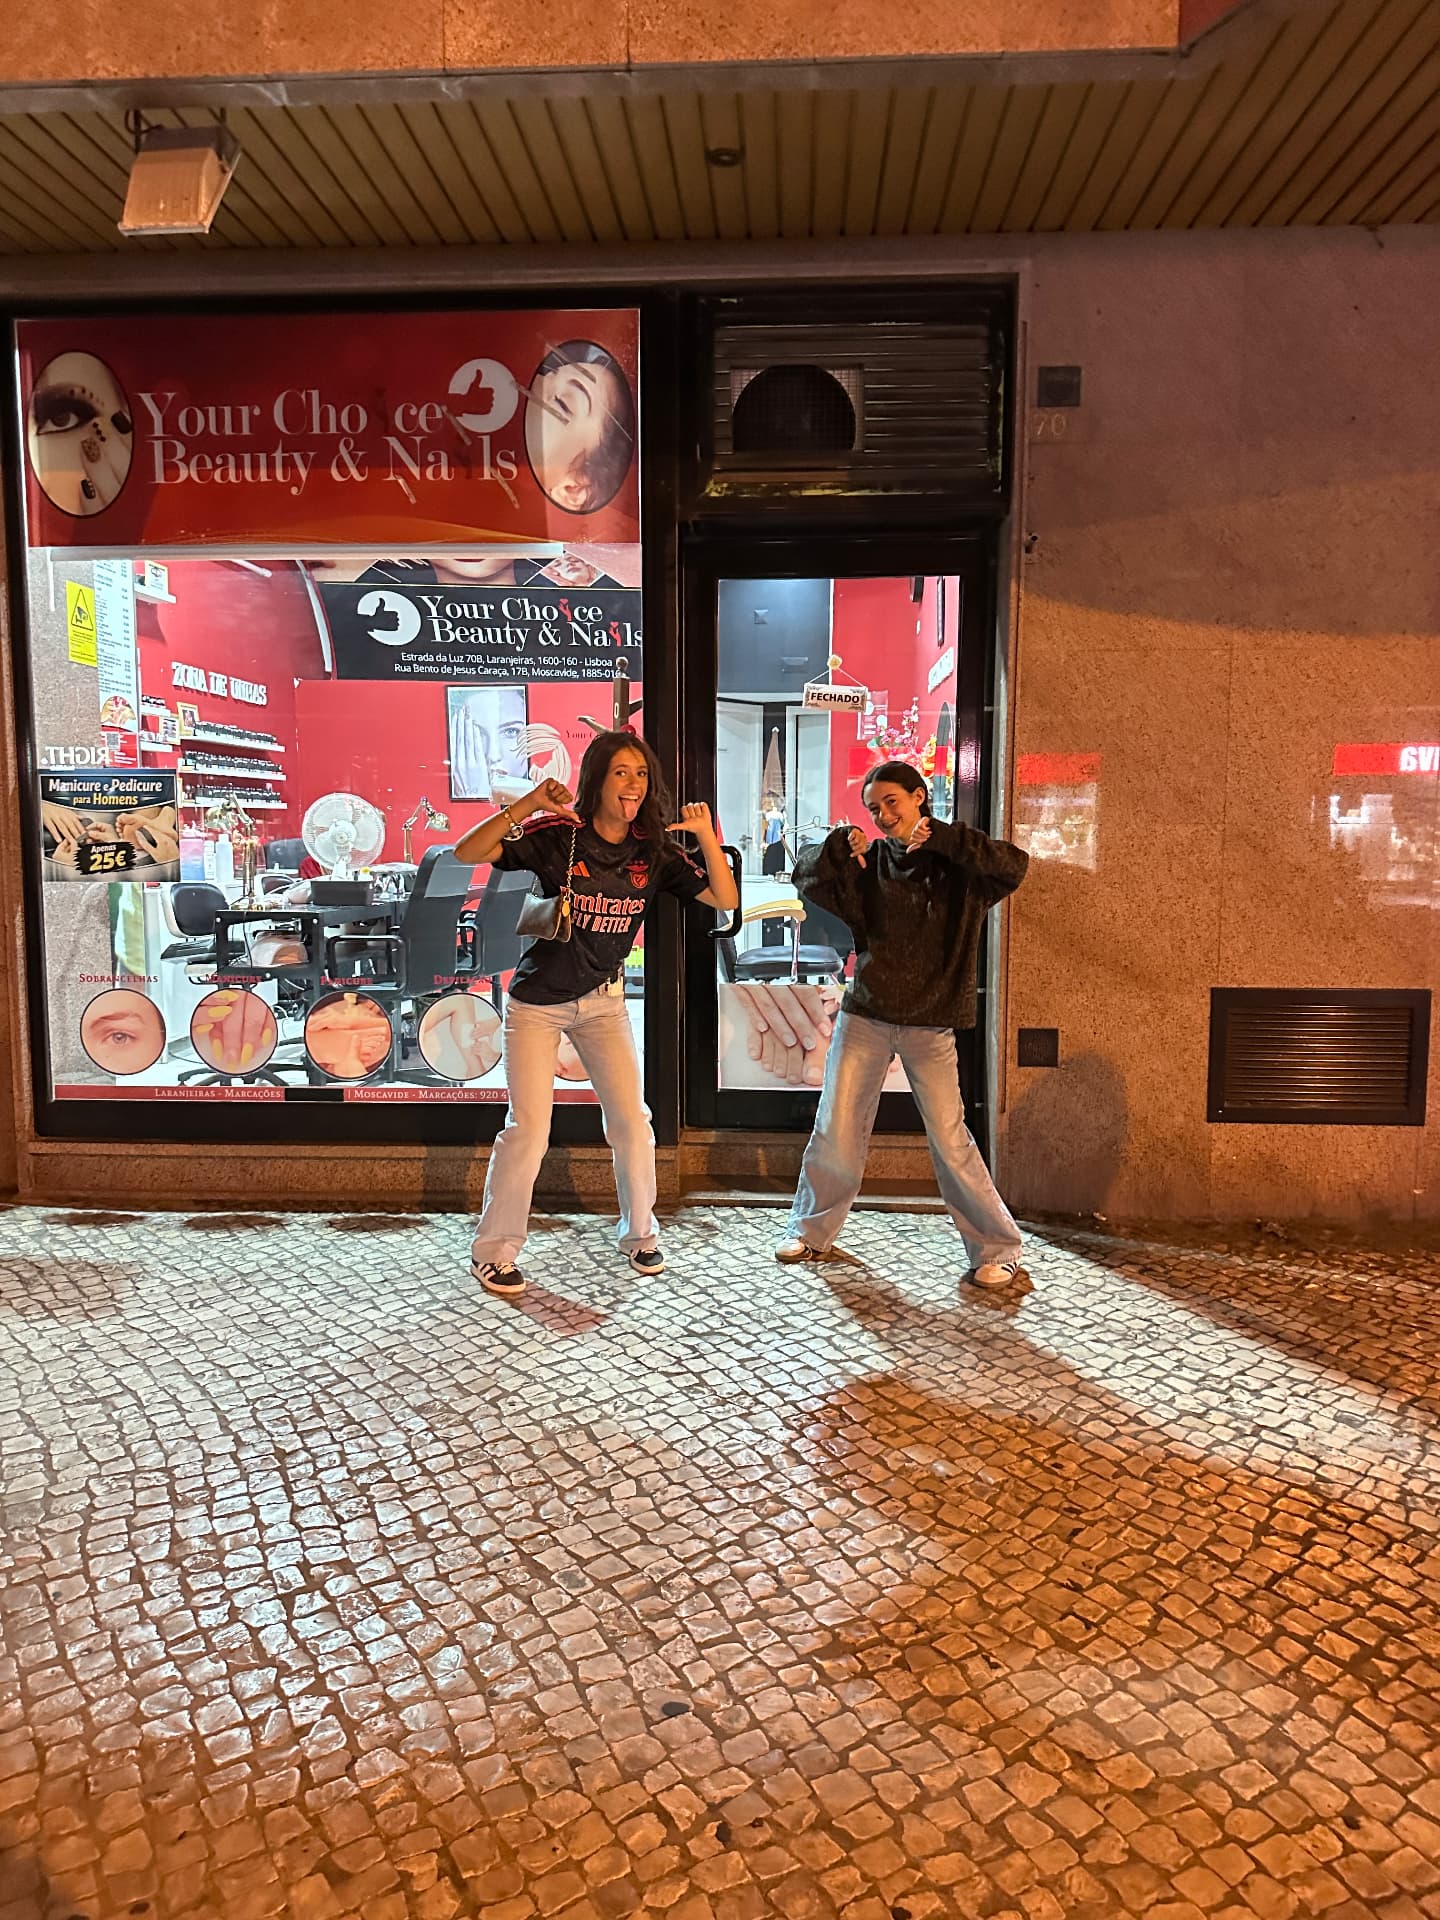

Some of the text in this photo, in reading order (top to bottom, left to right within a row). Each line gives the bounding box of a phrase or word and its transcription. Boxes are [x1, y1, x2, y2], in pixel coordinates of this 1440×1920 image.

[137, 391, 261, 438] Your
[145, 439, 318, 496] Beauty
[330, 437, 369, 482] &
[416, 595, 494, 620] Your
[427, 618, 531, 651] Beauty
[538, 621, 561, 646] &
[401, 652, 434, 662] Estrada
[435, 653, 447, 662] da
[449, 654, 464, 663] Luz
[465, 654, 485, 664] 70B,
[486, 654, 536, 666] Laranjeiras,
[538, 656, 578, 666] 1600-160
[584, 657, 613, 667] Lisboa
[394, 664, 412, 673] Rua
[413, 664, 439, 673] Bento
[441, 665, 452, 673] de
[452, 666, 477, 676] Jesus
[478, 666, 509, 677] Caraça,
[531, 668, 580, 678] Moscavide,
[171, 661, 208, 692] ZONA
[208, 671, 228, 697] DE
[810, 692, 860, 704] FECHADO
[48, 778, 163, 792] Manicure e Pedicure
[73, 793, 139, 805] para Homens
[90, 844, 117, 854] Apenas
[89, 850, 127, 872] 25€
[591, 915, 633, 934] BETTER
[79, 973, 159, 983] SOBRANCELHAS
[154, 1088, 216, 1098] LARANJEIRAS
[354, 1089, 409, 1099] MOSCAVIDE
[479, 1090, 498, 1100] 920
